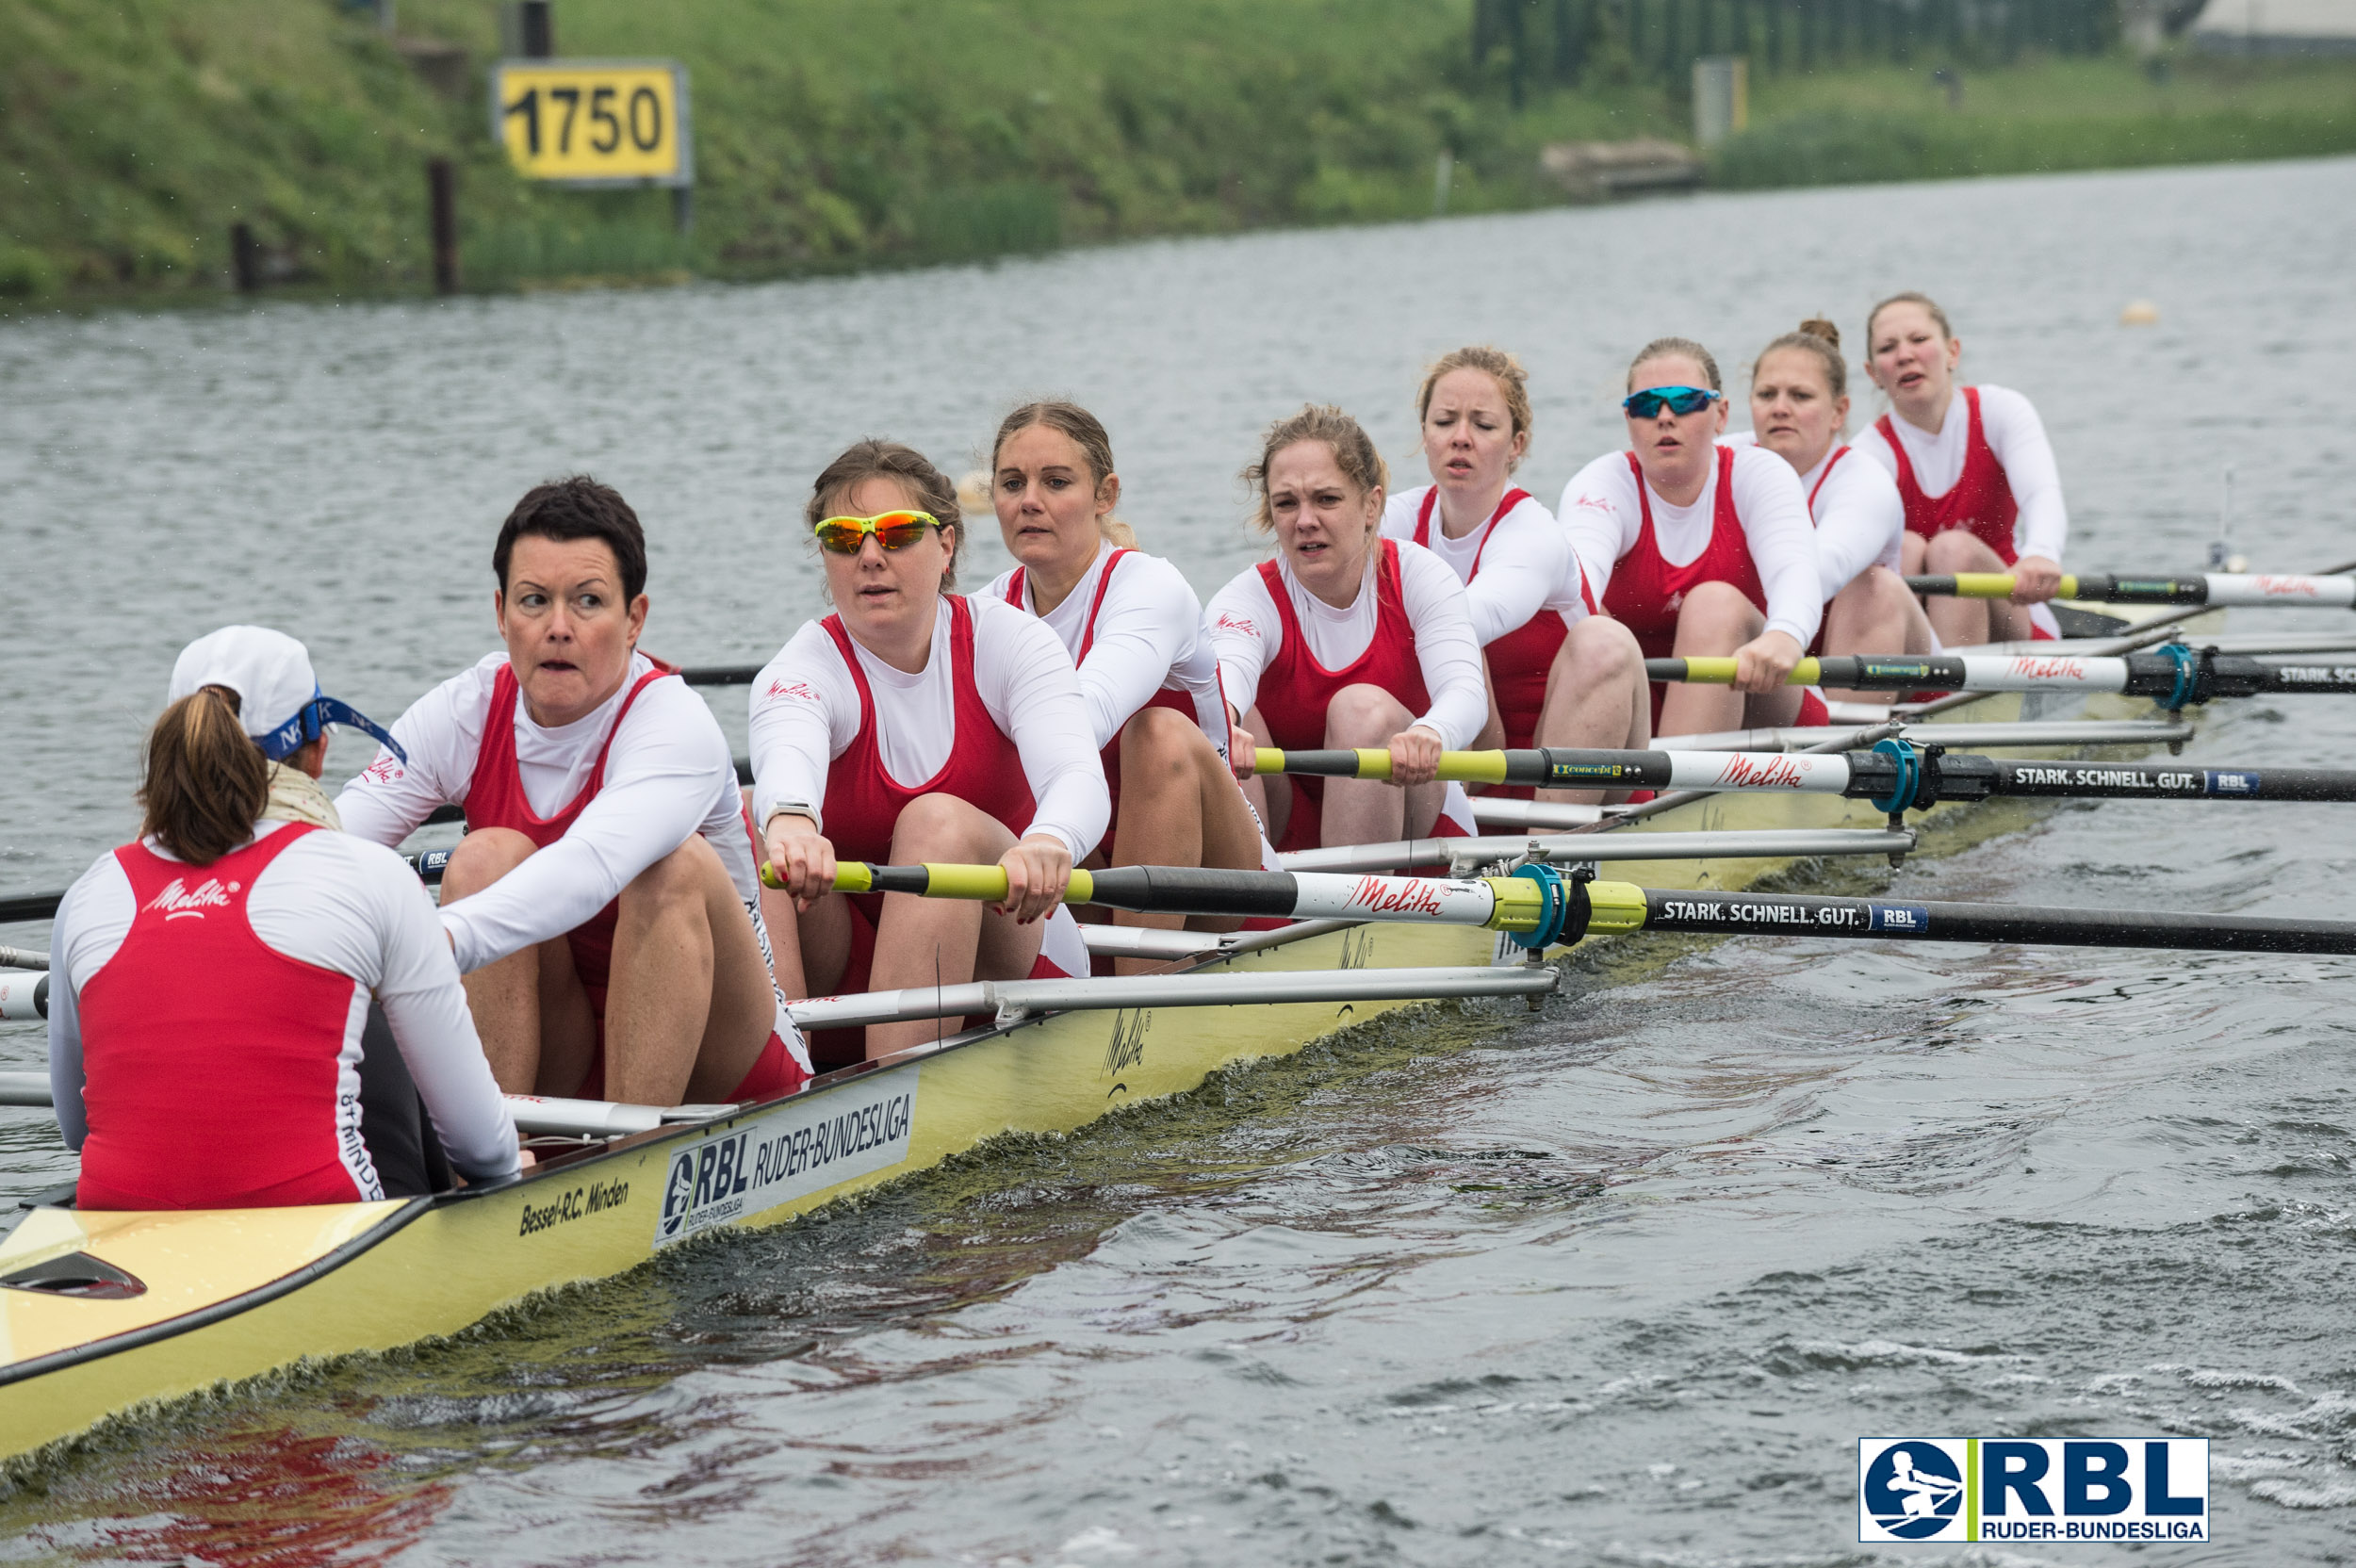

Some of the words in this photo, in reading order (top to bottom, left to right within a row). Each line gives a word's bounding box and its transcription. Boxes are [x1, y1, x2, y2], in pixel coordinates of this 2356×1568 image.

[503, 86, 662, 155] 1750
[2015, 768, 2072, 786] STARK.
[2075, 769, 2155, 789] SCHNELL.
[2157, 772, 2196, 790] GUT.
[2217, 774, 2249, 789] RBL
[427, 852, 448, 866] RBL
[1664, 901, 1726, 922] STARK.
[1729, 904, 1815, 924] SCHNELL.
[1819, 906, 1860, 926] GUT.
[1883, 909, 1917, 924] RBL
[752, 1093, 910, 1189] RUDER-BUNDESLIGA
[693, 1133, 749, 1208] RBL
[519, 1189, 582, 1237] Bessel-R.C.
[585, 1176, 630, 1217] Minden
